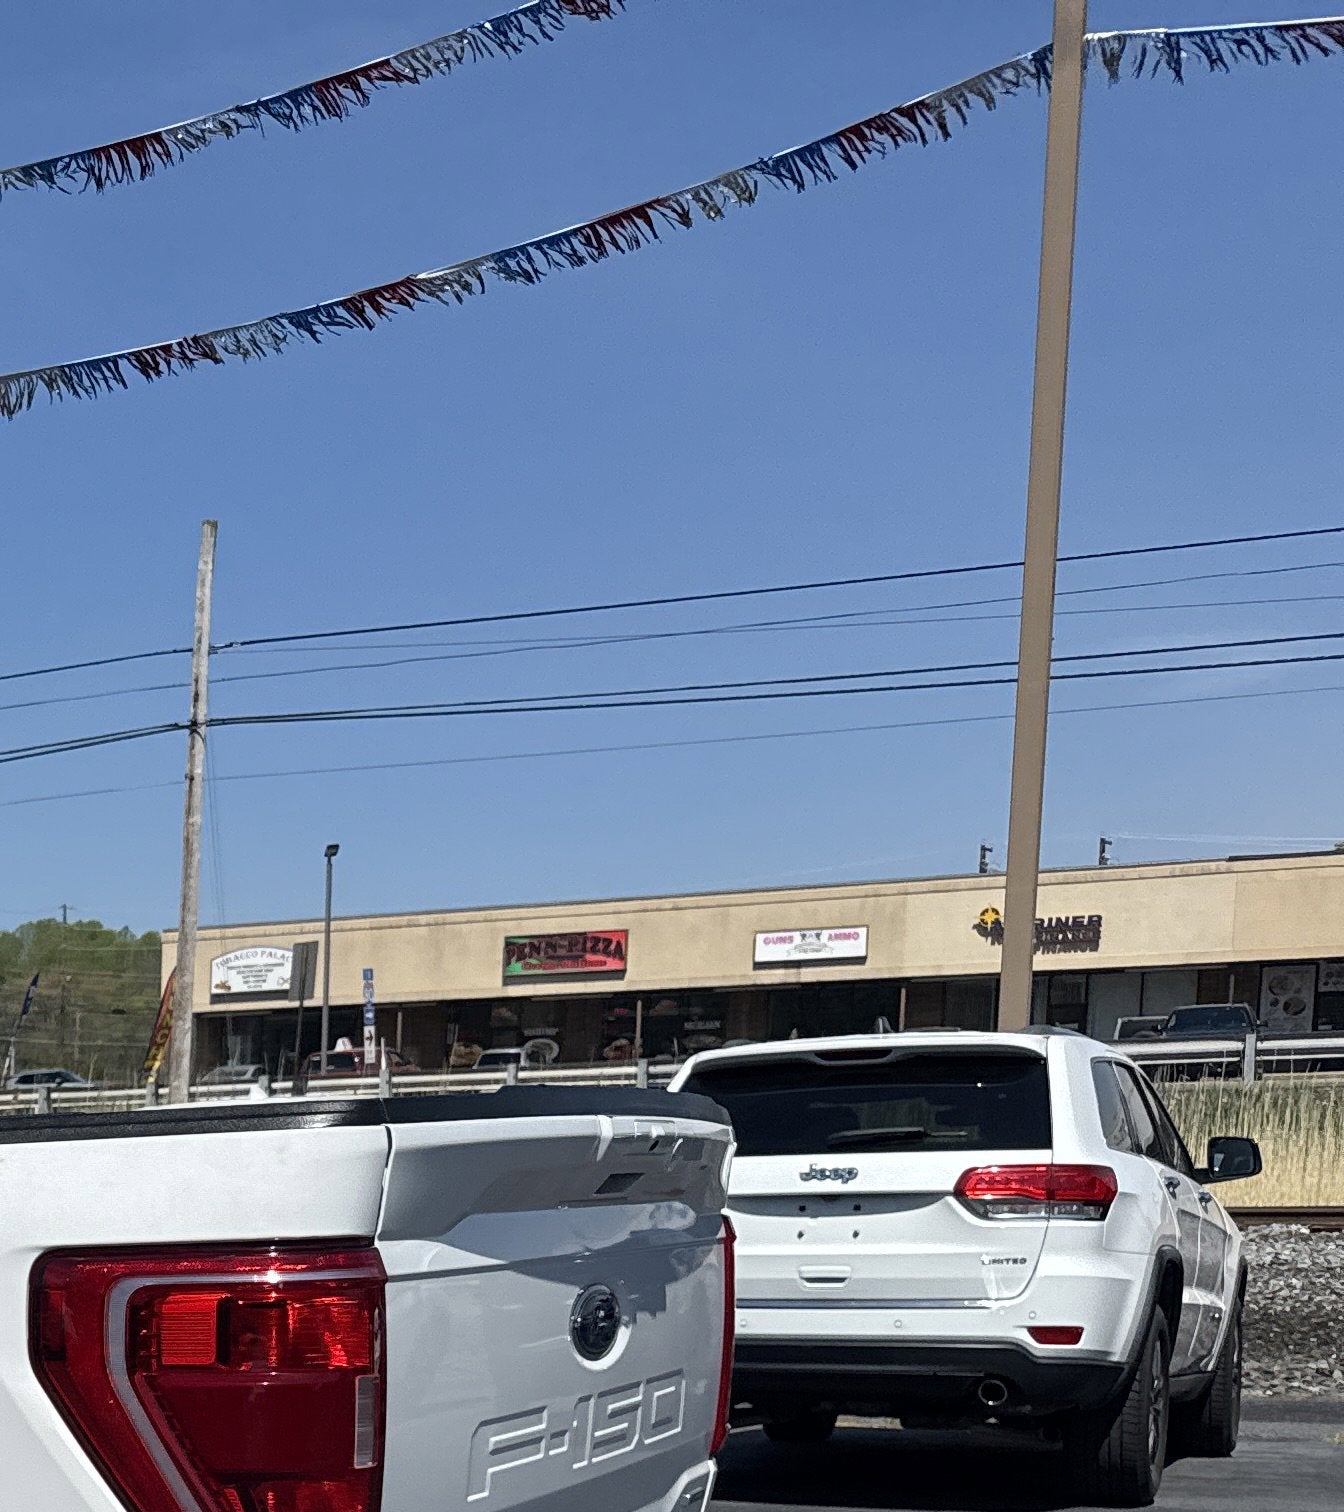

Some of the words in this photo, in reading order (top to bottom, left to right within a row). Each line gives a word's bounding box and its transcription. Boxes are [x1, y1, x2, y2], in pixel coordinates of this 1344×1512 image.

[995, 914, 1102, 930] RINER
[763, 935, 794, 945] GUNS
[828, 931, 860, 942] AMMO
[215, 950, 259, 969] TOBACCO
[261, 950, 291, 963] PALAC
[799, 1163, 858, 1184] Jeep
[467, 1368, 686, 1502] F-150
